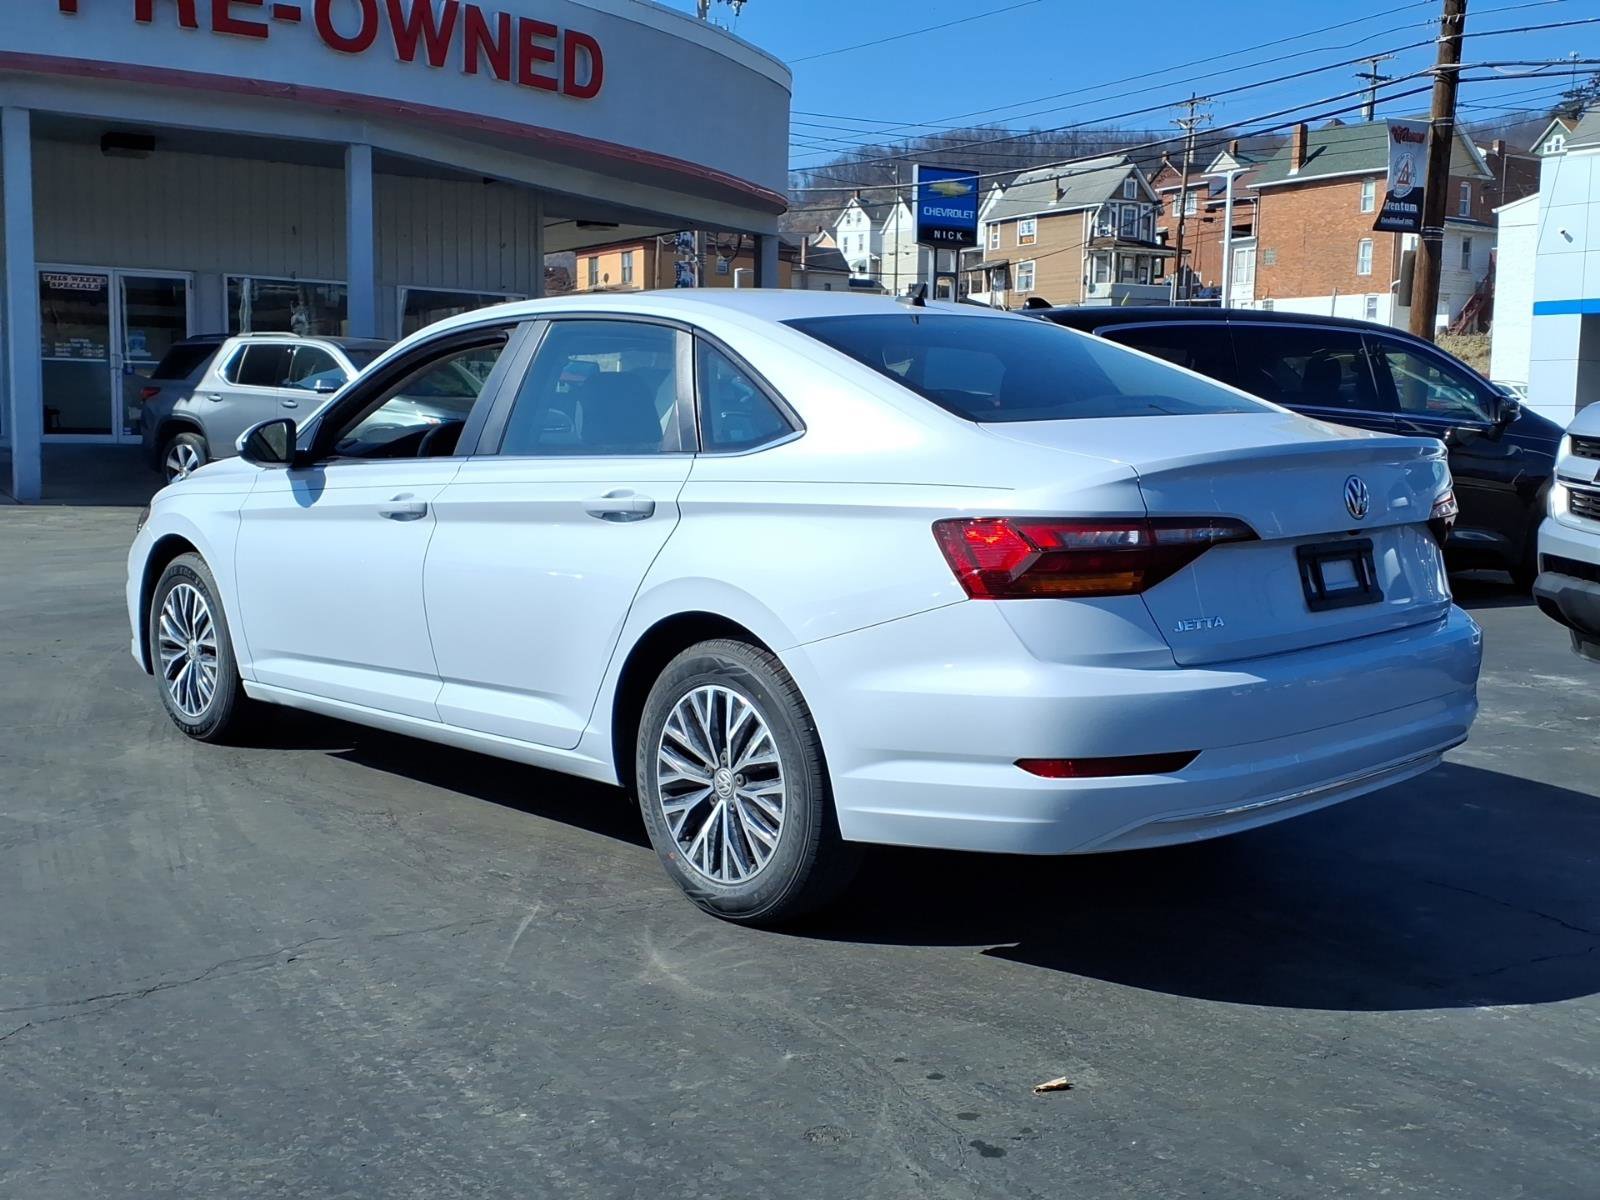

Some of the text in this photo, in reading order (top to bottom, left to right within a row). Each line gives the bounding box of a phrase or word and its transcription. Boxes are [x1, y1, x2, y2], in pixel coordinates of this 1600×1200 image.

[923, 206, 975, 219] CHEVROLET
[933, 230, 963, 240] NICK
[49, 281, 100, 290] SPECIALS
[1174, 616, 1225, 632] JETTA
